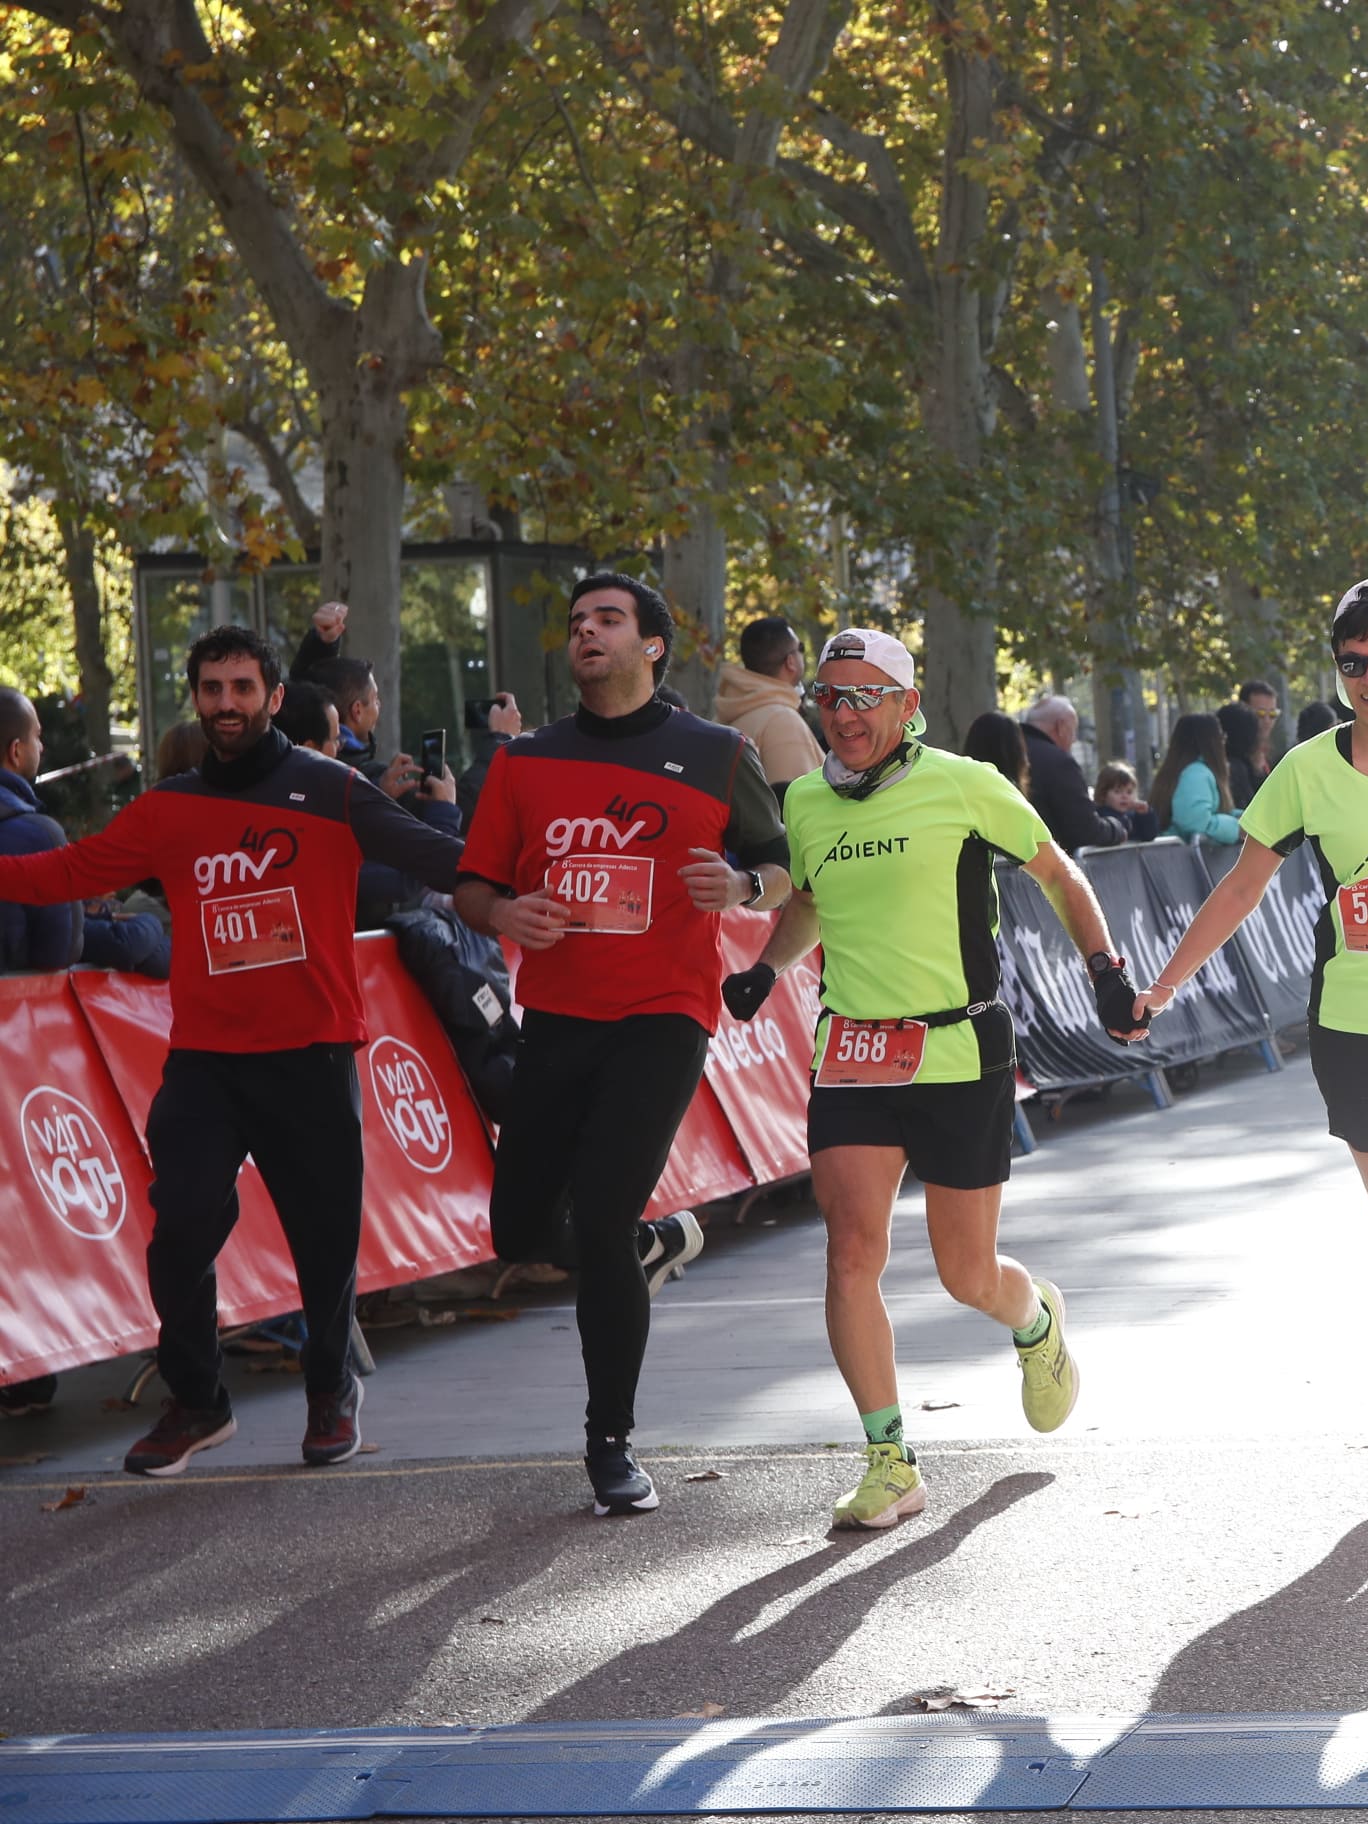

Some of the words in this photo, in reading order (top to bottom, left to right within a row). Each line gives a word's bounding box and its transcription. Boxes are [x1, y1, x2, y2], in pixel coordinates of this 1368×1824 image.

[545, 817, 646, 856] gmv
[822, 835, 910, 865] ADIENT
[194, 848, 278, 895] gmv
[557, 870, 610, 902] 402
[214, 909, 258, 944] 401
[836, 1030, 888, 1062] 568
